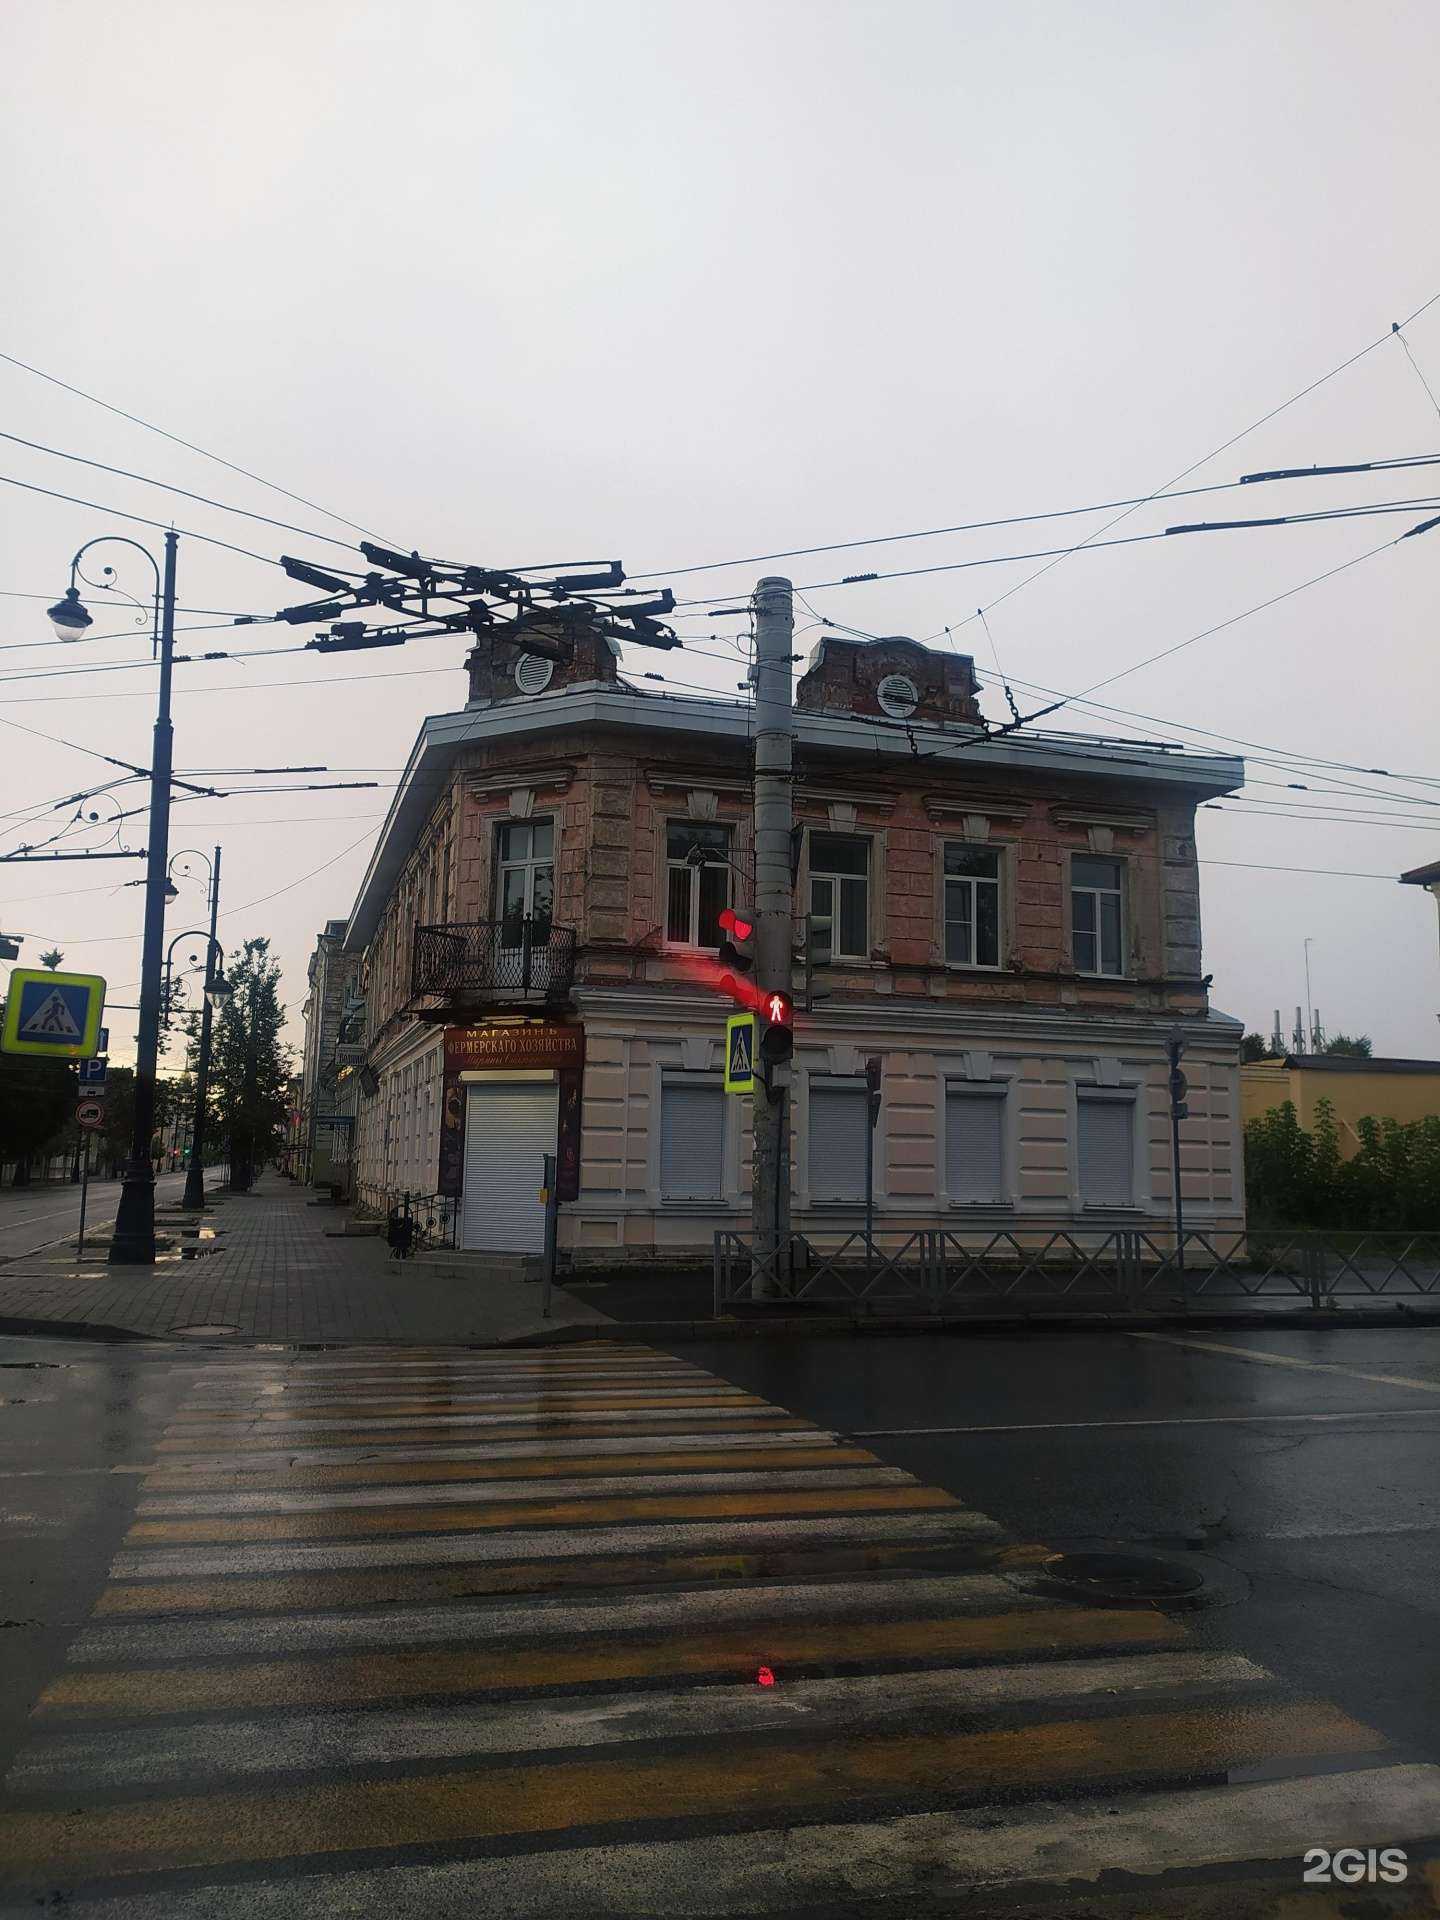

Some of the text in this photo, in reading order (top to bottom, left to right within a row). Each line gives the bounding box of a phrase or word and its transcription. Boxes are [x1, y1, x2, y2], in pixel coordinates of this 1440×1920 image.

[466, 1028, 558, 1038] МАГАЗИНЪ
[448, 1038, 577, 1055] ФЕРМЕРСКАГО ХОЗЯЙСТВА
